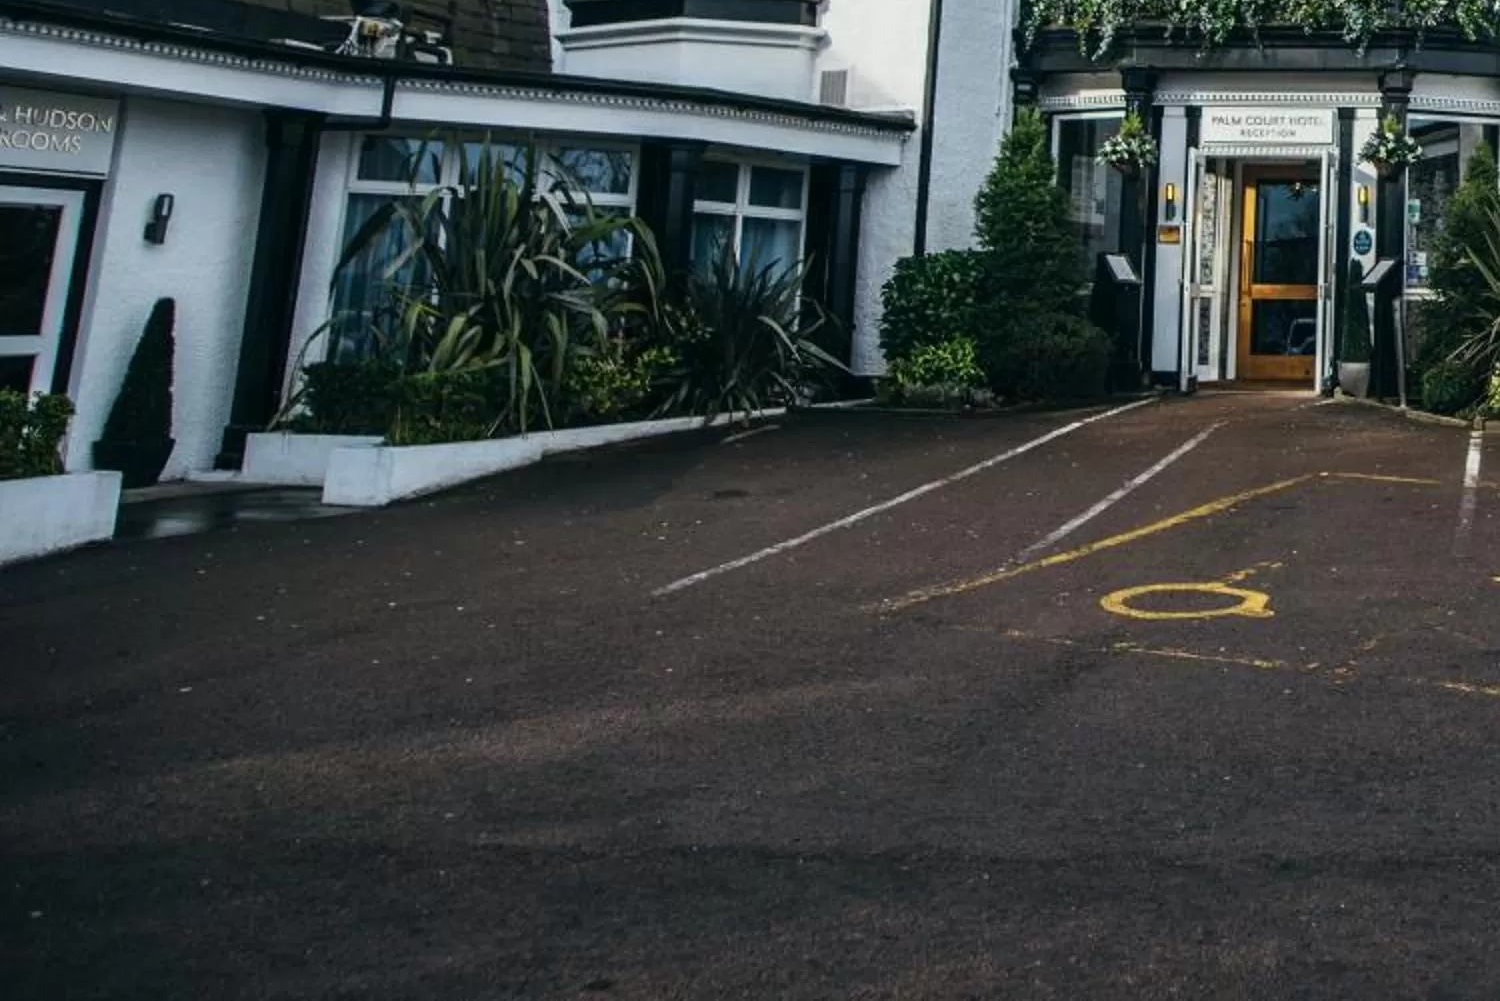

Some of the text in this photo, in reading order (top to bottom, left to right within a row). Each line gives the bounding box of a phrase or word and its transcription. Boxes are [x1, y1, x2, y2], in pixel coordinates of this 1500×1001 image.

[15, 106, 113, 132] HUDSON
[1211, 116, 1241, 126] PALM
[1245, 116, 1284, 126] COURT
